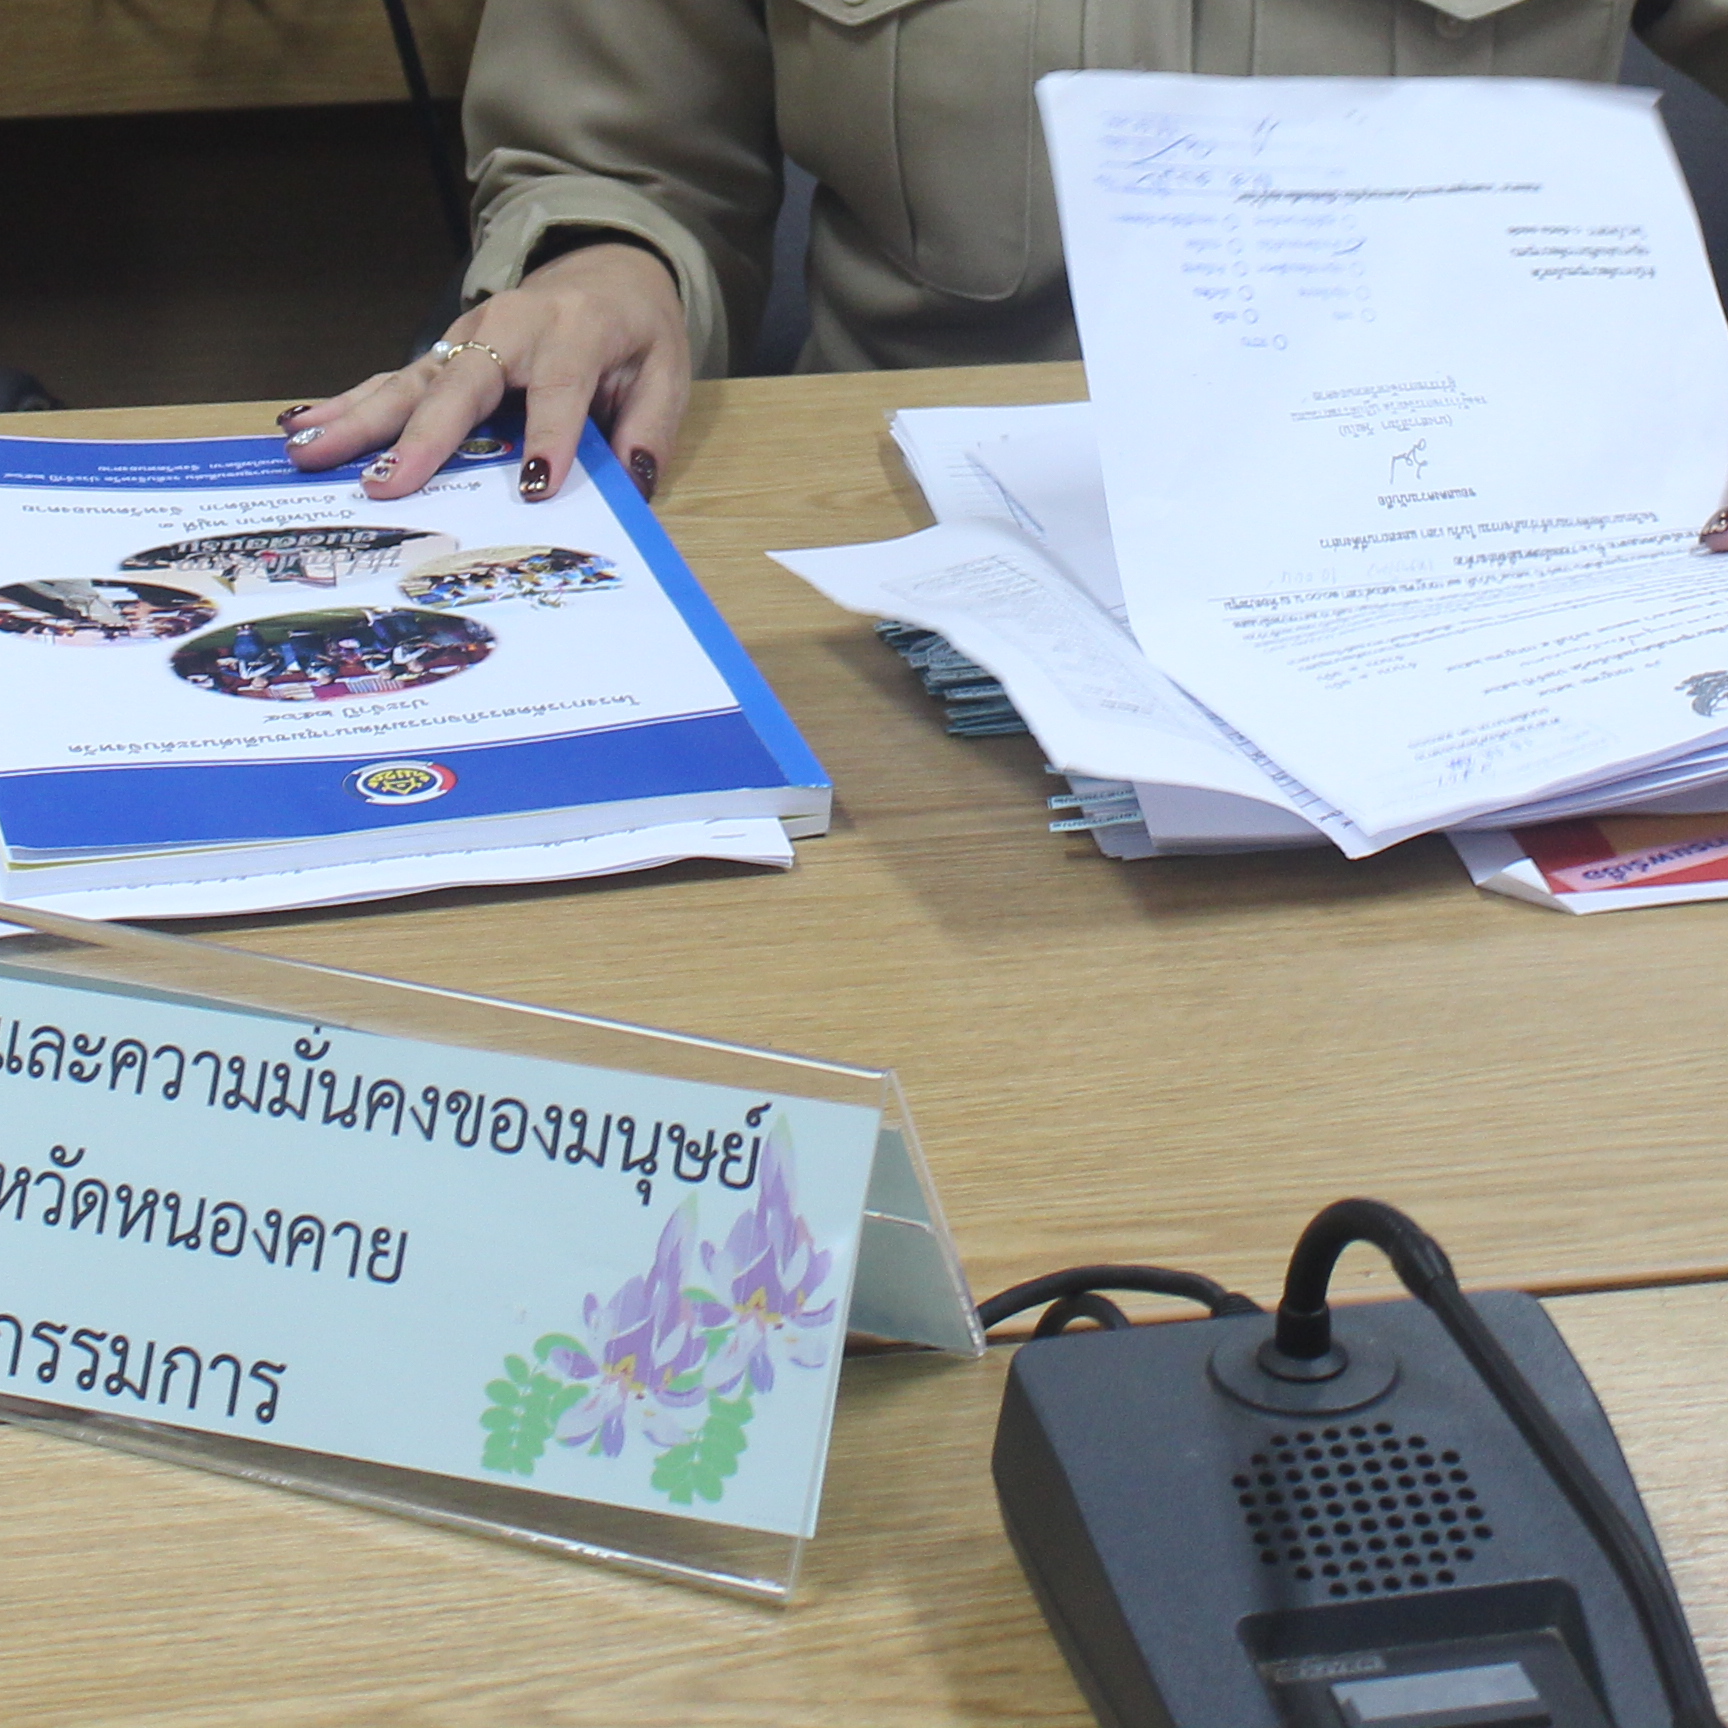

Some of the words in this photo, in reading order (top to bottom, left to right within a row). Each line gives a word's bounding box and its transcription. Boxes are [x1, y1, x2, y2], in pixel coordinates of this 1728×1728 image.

[21, 504, 183, 517] จังหวัดหนองคาย
[235, 509, 355, 526] บ้านโพธิ์ตาก
[182, 518, 228, 532] หมู่ที่
[342, 699, 428, 720] ประจำปี
[67, 694, 639, 754] โครงการคัดสรรกิจกรรมพัฒนาชุมชนดีเด่นระดับจังหวัด
